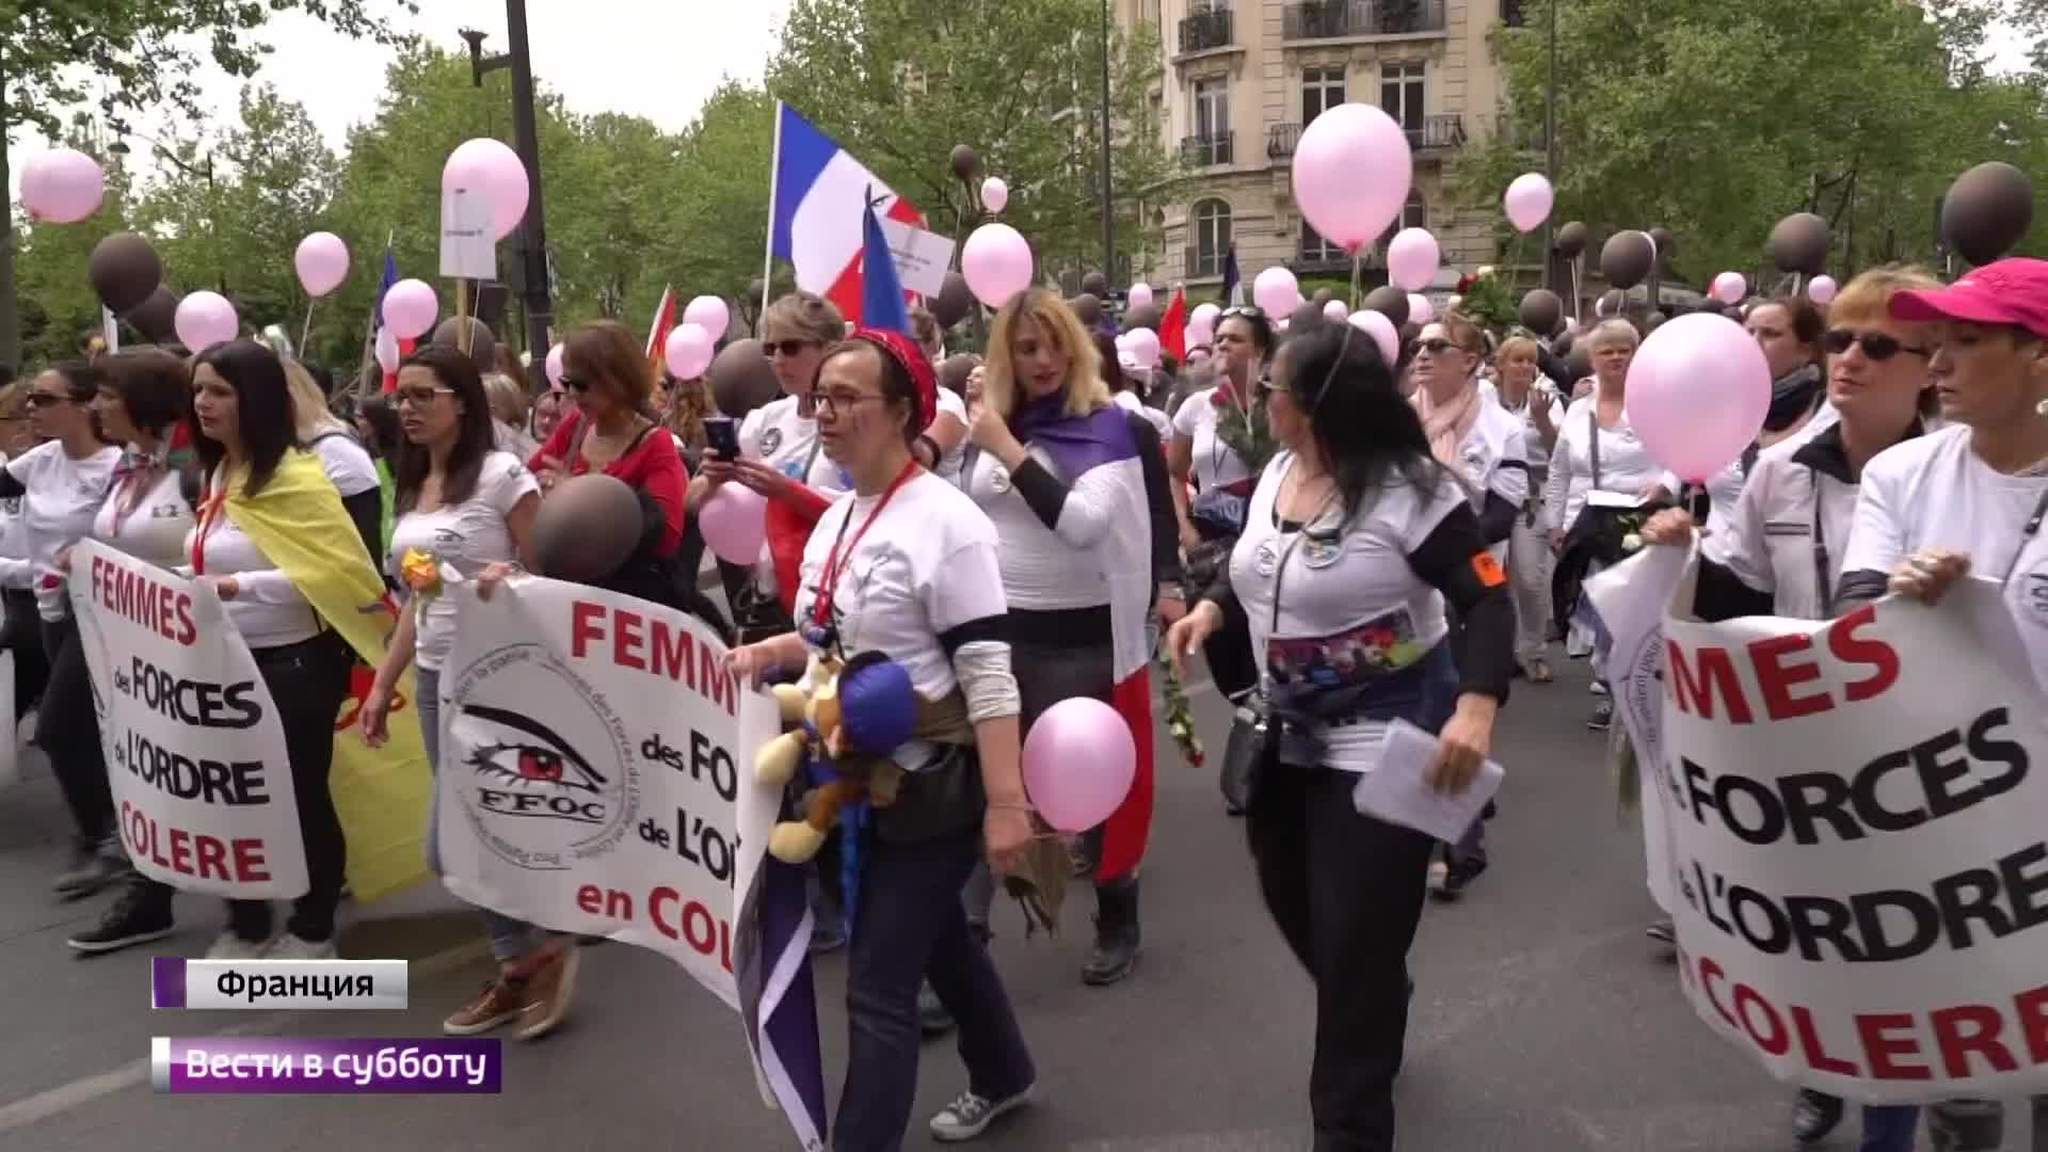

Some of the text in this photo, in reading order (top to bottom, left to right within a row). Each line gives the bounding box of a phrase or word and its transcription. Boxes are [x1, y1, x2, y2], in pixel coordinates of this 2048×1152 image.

[92, 556, 197, 646] FEMMES
[132, 656, 262, 729] FORCES
[571, 600, 739, 716] FEMM
[1663, 602, 1899, 725] MES
[127, 728, 270, 805] L'ORDRE
[478, 788, 605, 820] FFOC
[641, 729, 737, 803] des FO
[1681, 707, 2029, 845] FORCES
[121, 800, 272, 882] COLERE
[639, 817, 670, 849] de
[577, 884, 735, 973] en COL
[1694, 841, 2048, 963] L'ORDRE
